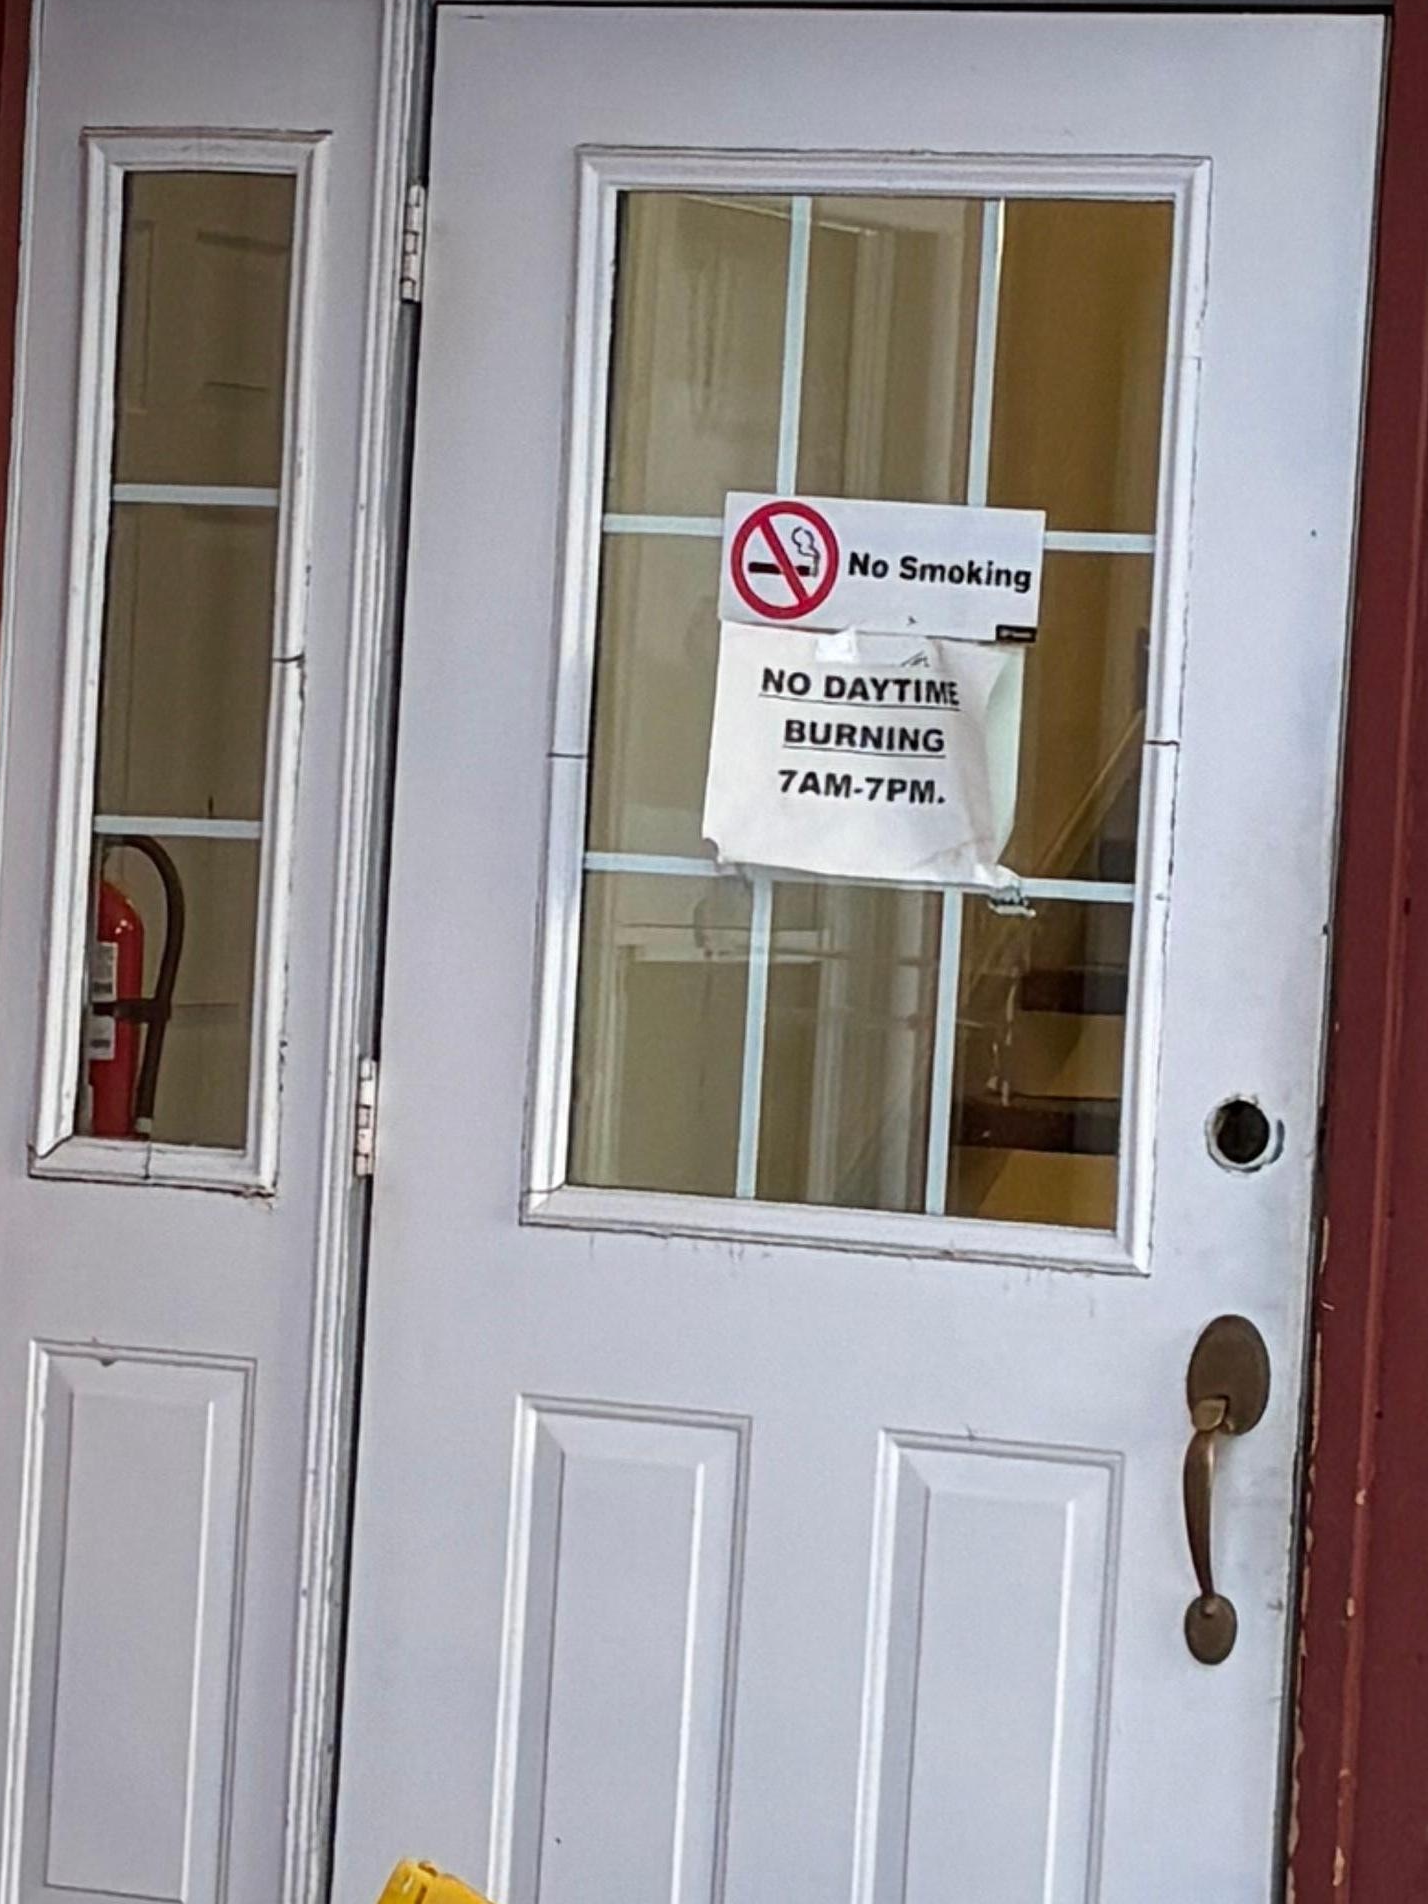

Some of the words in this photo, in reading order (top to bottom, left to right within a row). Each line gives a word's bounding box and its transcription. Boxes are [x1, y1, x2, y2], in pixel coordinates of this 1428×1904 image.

[848, 551, 890, 579] No
[899, 556, 1032, 594] Smoking
[761, 667, 812, 696] NO
[823, 675, 960, 706] DAYTIME
[783, 719, 945, 753] BURNING
[778, 769, 946, 804] 7AM-7PM.
